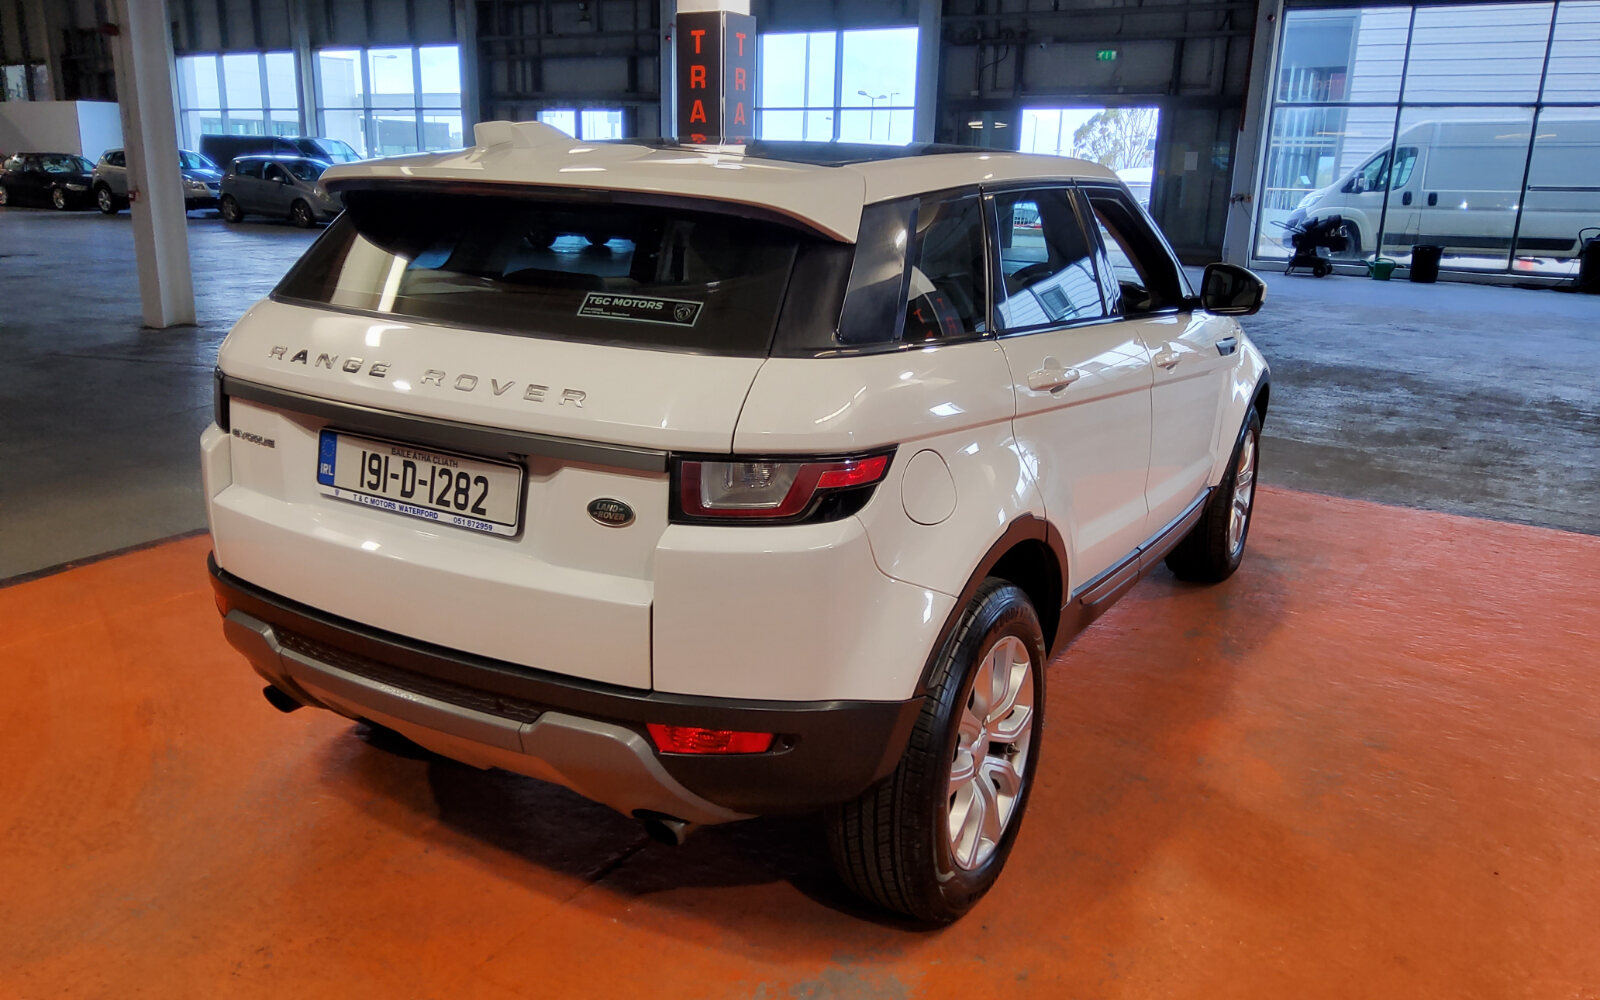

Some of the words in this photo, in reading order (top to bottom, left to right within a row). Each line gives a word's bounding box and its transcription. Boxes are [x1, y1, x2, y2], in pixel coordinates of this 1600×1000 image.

[589, 296, 612, 306] T&C
[612, 299, 664, 310] MOTORS
[268, 345, 391, 378] RANGE
[420, 369, 587, 408] ROVER
[320, 462, 334, 476] IRL
[432, 456, 459, 468] CLIATH
[360, 450, 489, 516] 191-D-1282
[370, 498, 396, 510] MOTORS
[399, 504, 439, 519] WATERFORD
[596, 503, 619, 512] LAND
[597, 511, 625, 520] ROVER
[453, 516, 466, 526] 051
[467, 519, 493, 532] 872959
